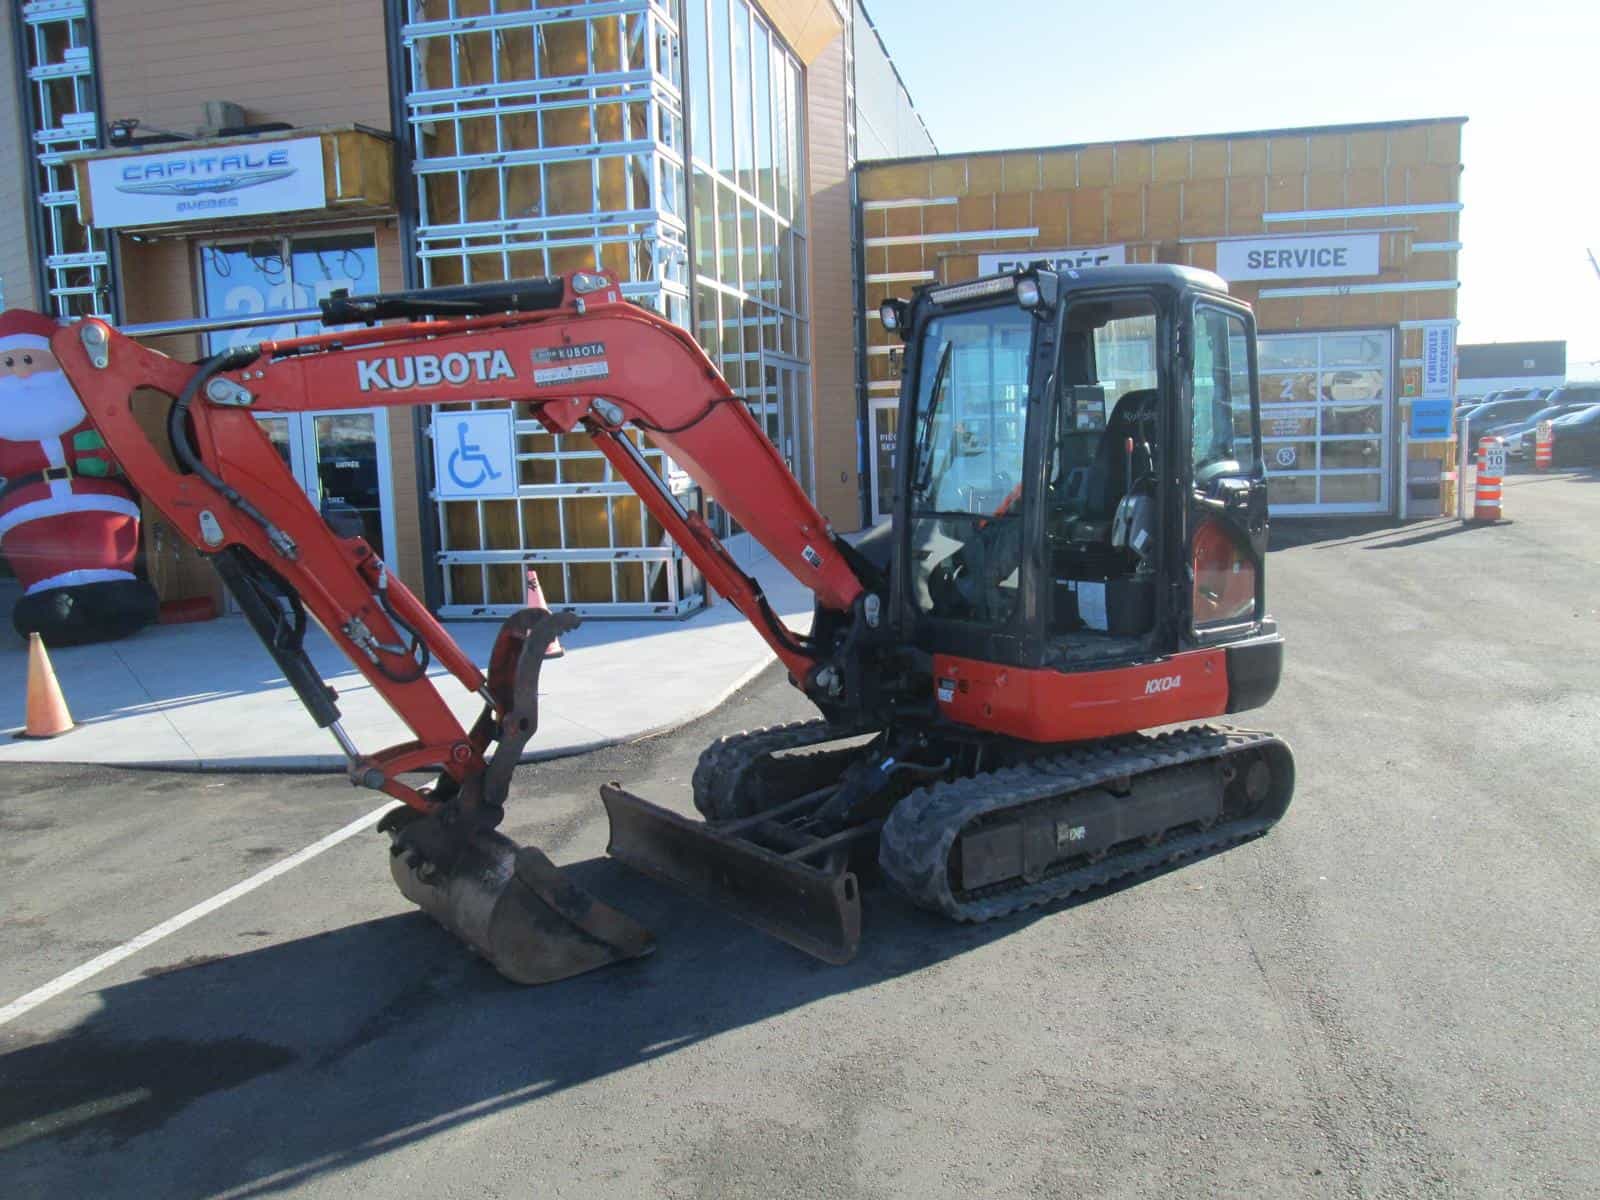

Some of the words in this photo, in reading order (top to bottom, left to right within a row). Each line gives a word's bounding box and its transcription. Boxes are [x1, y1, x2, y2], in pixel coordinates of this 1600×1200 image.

[122, 149, 289, 181] CAPITALE
[1247, 247, 1348, 270] SERVICE
[356, 349, 516, 392] KUBOTA
[1280, 378, 1296, 399] 2
[1488, 456, 1503, 465] 10
